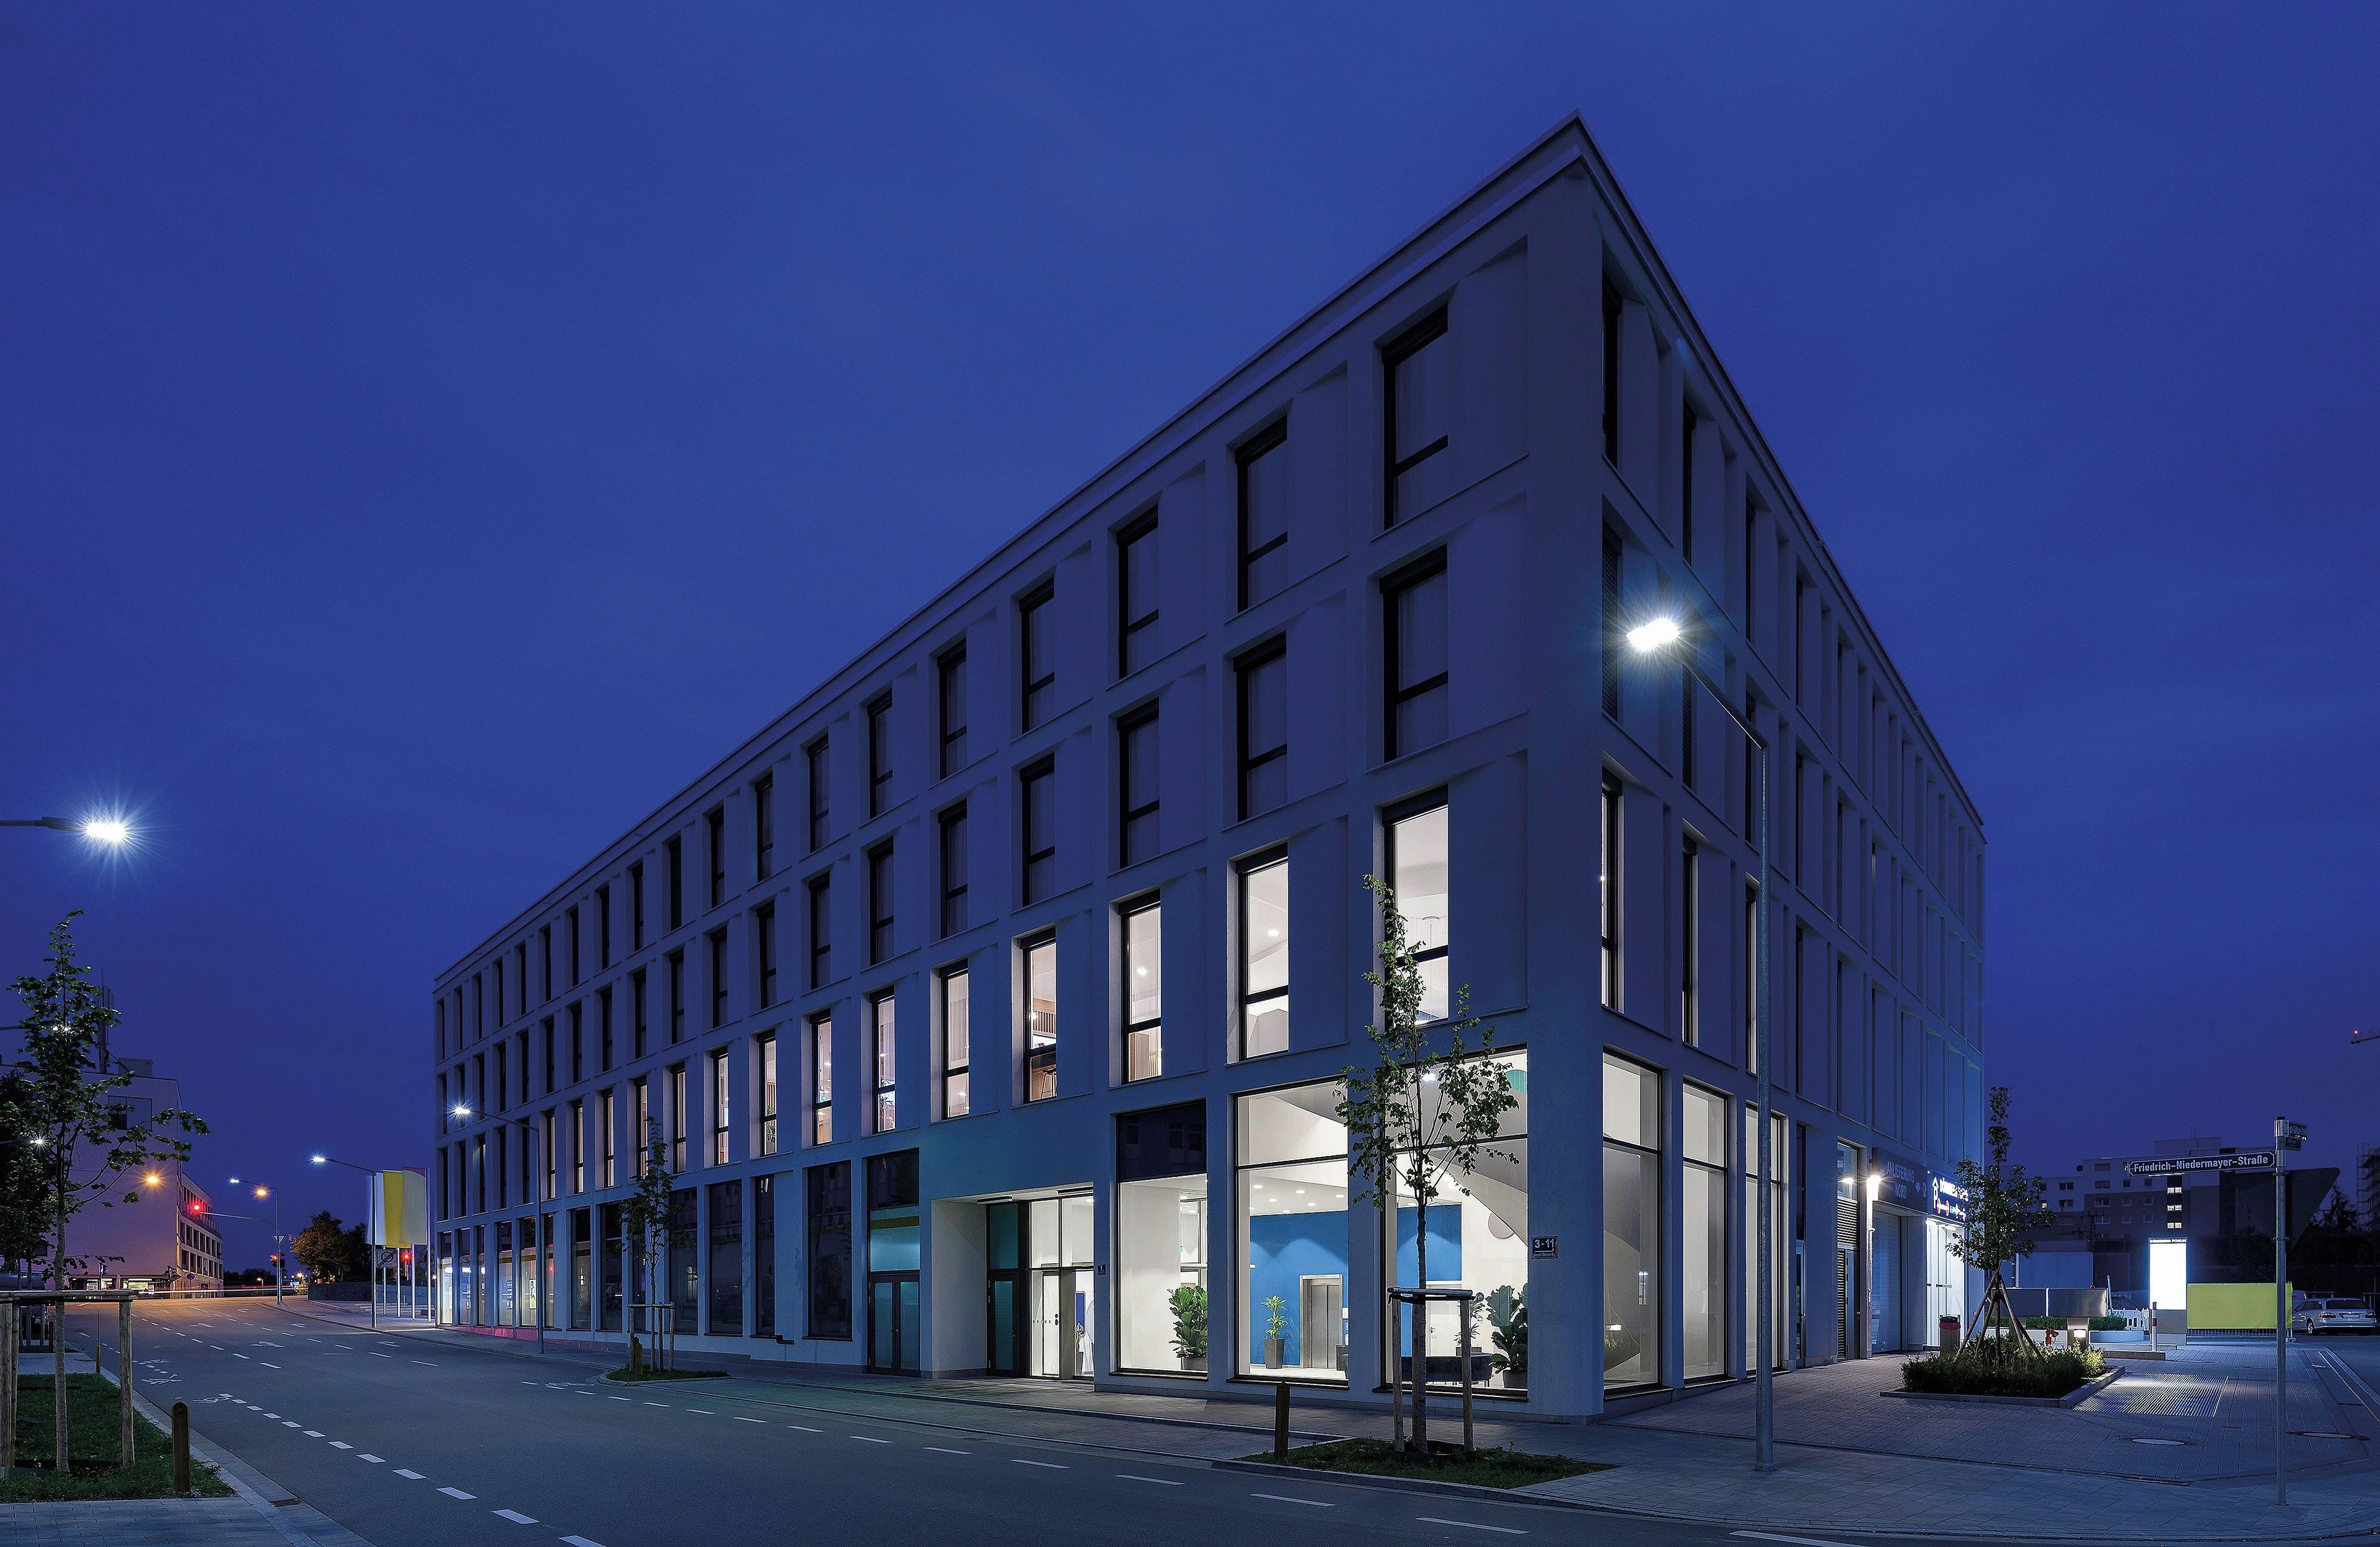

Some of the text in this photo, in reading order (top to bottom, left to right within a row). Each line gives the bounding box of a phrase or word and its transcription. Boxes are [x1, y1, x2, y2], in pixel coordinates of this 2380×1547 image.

[1887, 1160, 1915, 1183] ANLIEFERUNG
[2134, 1155, 2268, 1172] Friedrich-Niedermayer-Straße
[1895, 1183, 1907, 1199] NORD
[1535, 1238, 1554, 1248] 3-11
